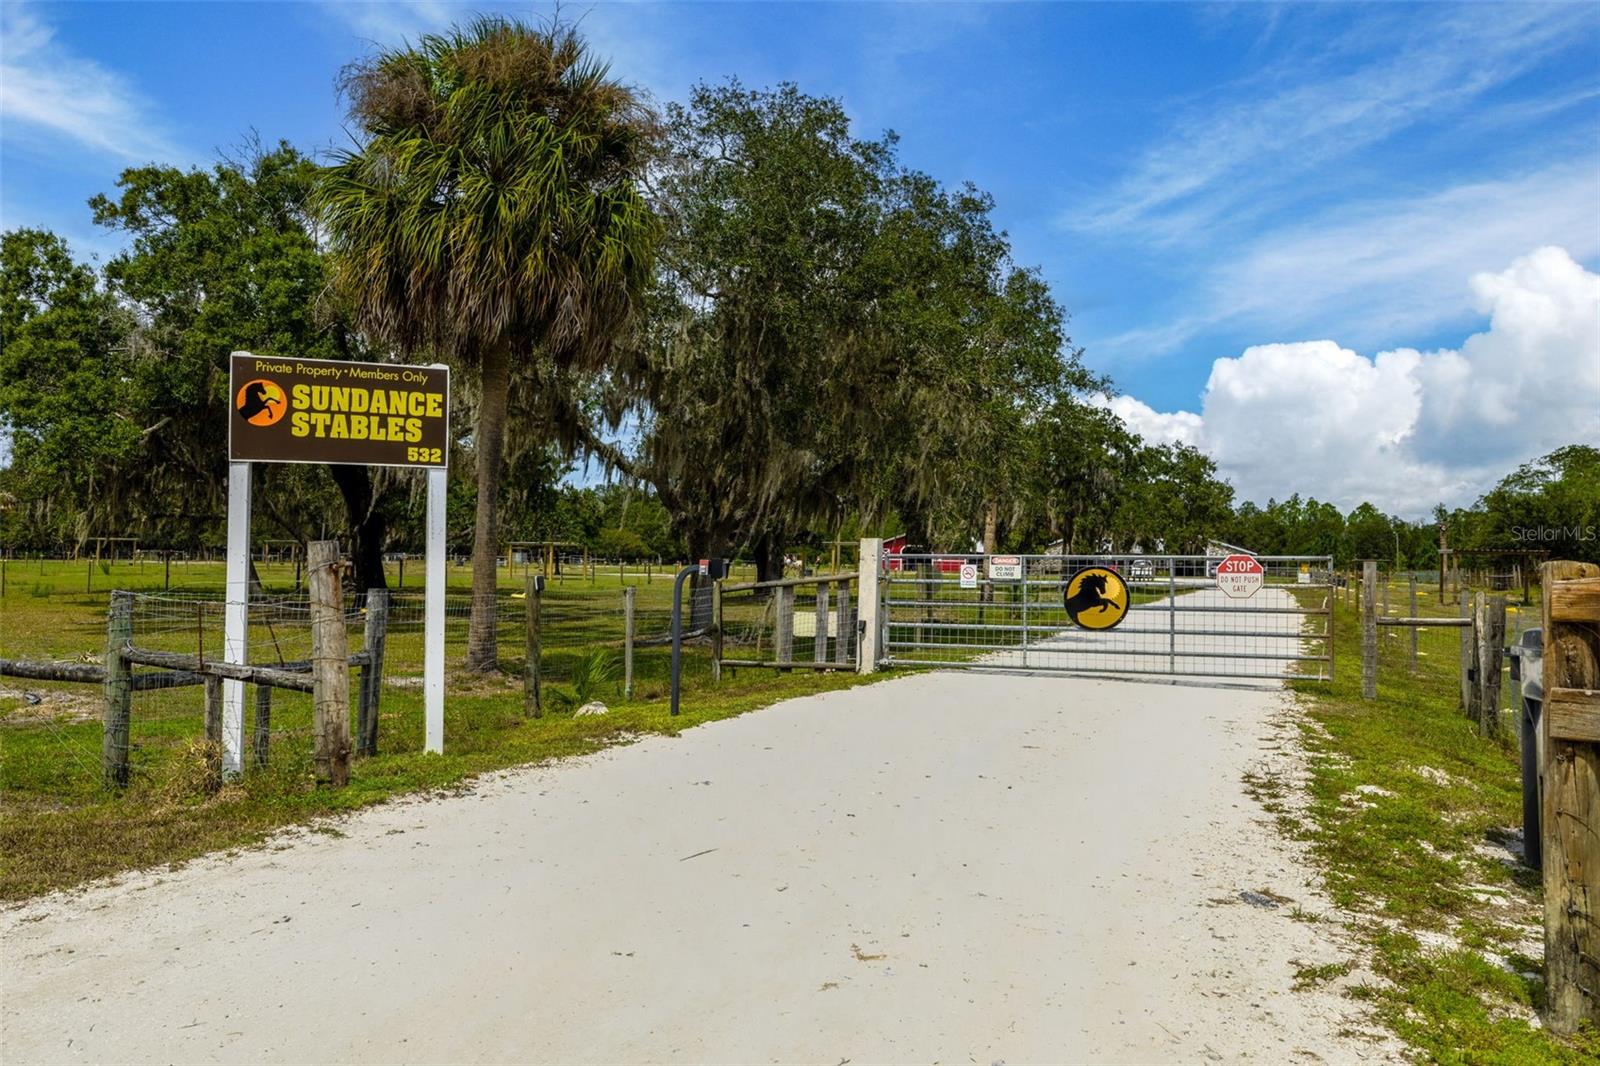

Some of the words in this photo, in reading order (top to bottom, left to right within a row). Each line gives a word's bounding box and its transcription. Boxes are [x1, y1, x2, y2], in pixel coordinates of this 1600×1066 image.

[255, 360, 292, 374] Private
[296, 363, 342, 380] Property
[349, 366, 399, 381] Members
[402, 370, 428, 385] Only
[291, 383, 443, 418] SUNDANCE
[291, 411, 423, 443] STABLES
[407, 446, 442, 463] 532
[1225, 560, 1254, 572] STOP
[1232, 585, 1247, 593] GATE
